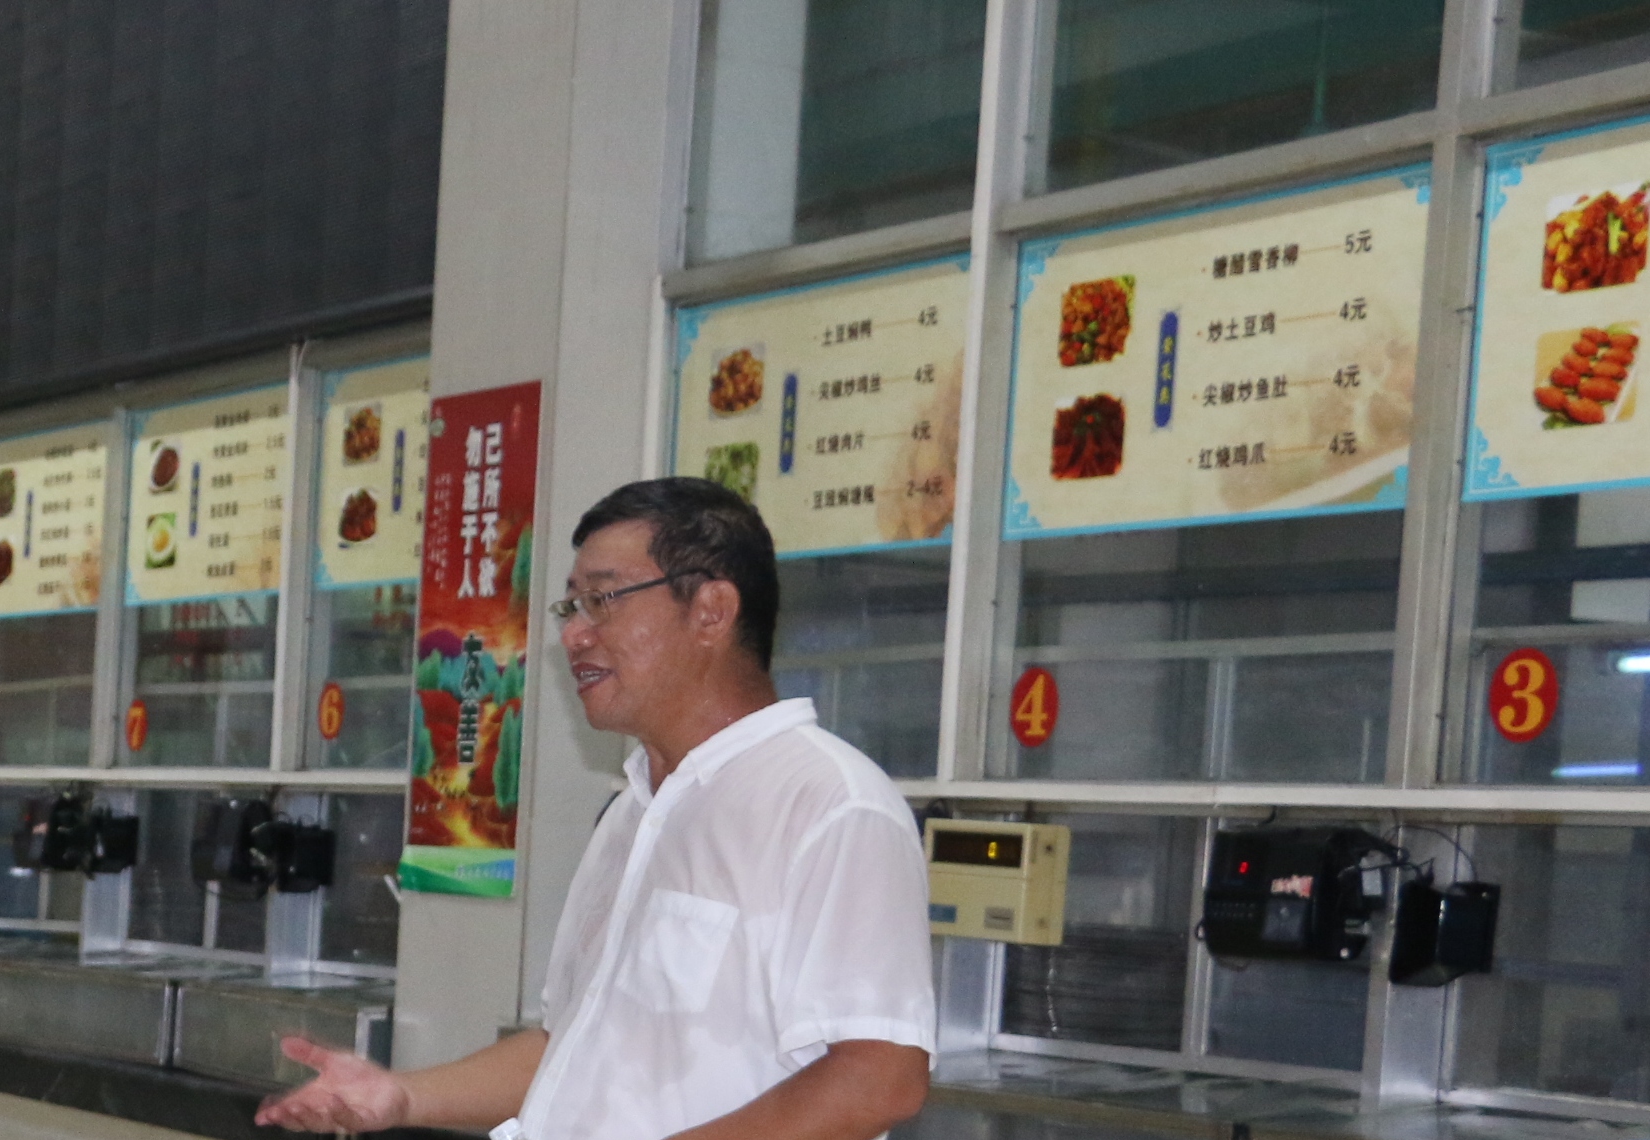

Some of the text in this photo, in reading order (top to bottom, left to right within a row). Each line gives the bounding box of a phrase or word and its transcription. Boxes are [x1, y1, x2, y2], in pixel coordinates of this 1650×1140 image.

[1345, 229, 1373, 254] 5元
[1339, 297, 1368, 321] 4元
[1333, 364, 1361, 388] 4元
[1329, 432, 1357, 455] 4元
[457, 425, 483, 599] 勿施于人
[478, 422, 503, 598] 己所不欲
[321, 689, 340, 736] 6
[457, 632, 483, 765] 友善
[1015, 674, 1049, 736] 4
[1499, 659, 1545, 733] 3
[128, 707, 144, 749] 7
